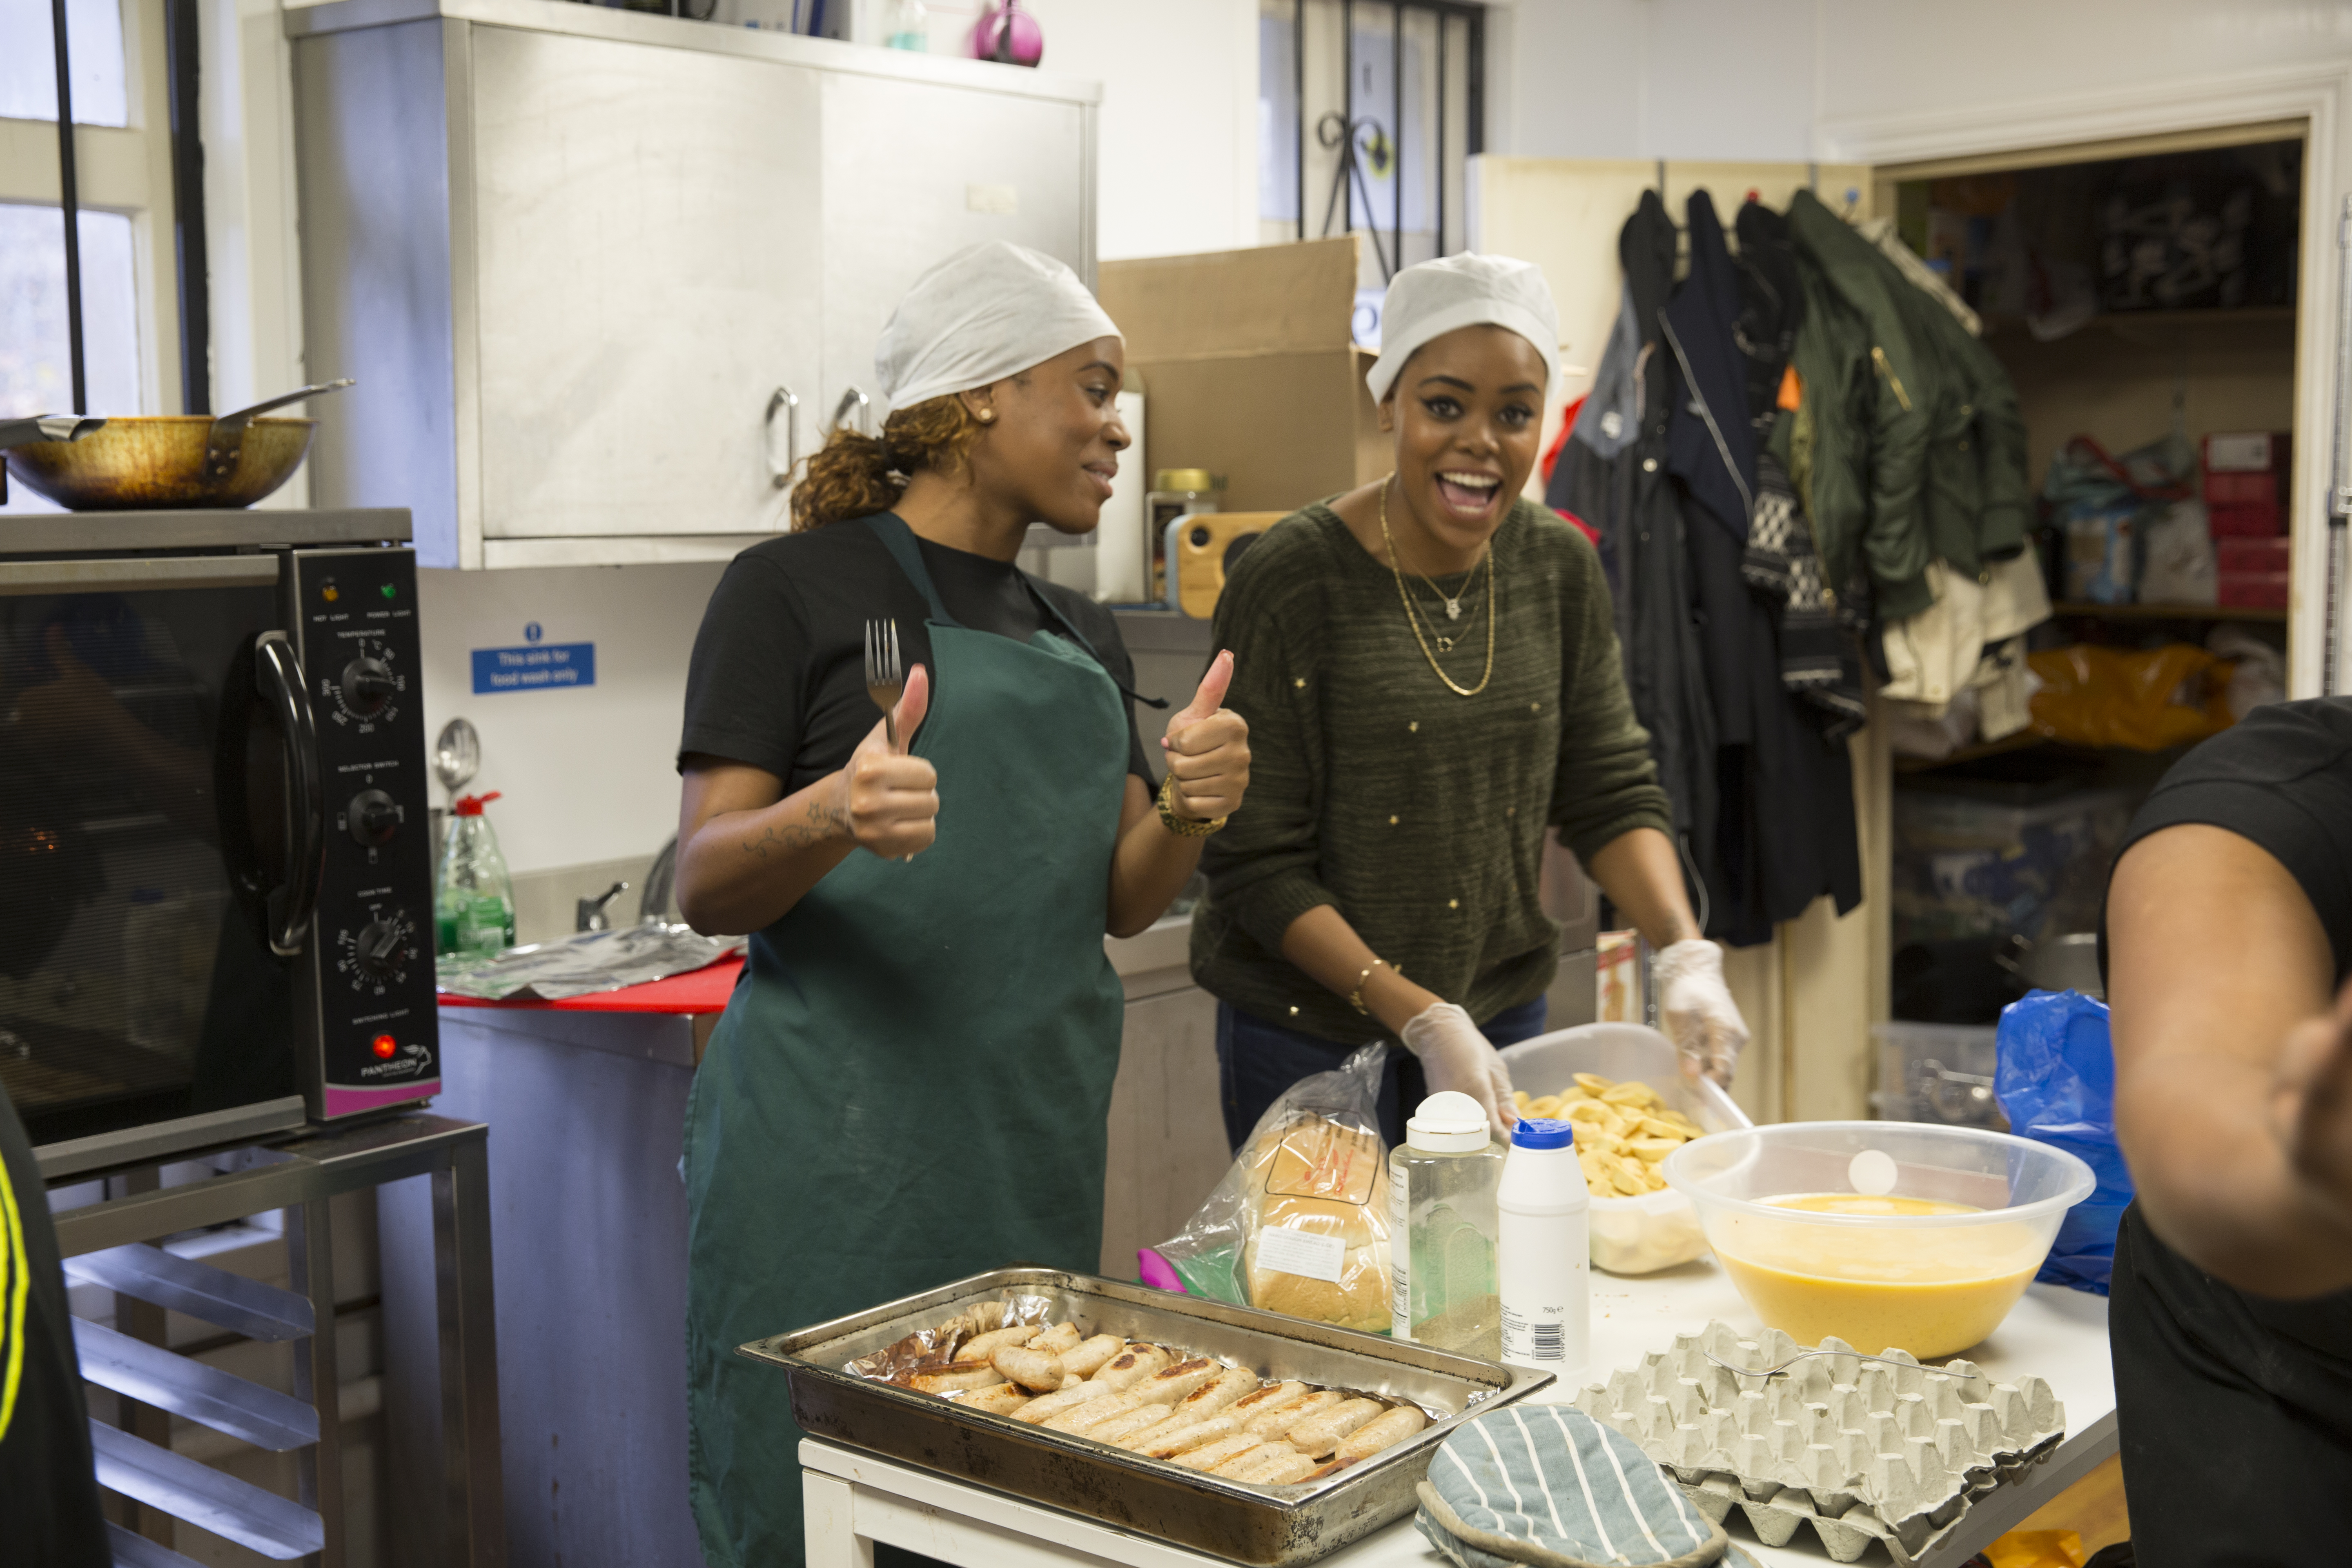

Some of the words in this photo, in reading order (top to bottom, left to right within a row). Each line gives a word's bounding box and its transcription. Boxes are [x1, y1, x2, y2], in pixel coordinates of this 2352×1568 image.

[337, 629, 385, 638] TEMPERATURE
[338, 763, 372, 772] SELECTOR
[374, 760, 399, 768] SWITCH
[352, 1013, 388, 1025] SWITCHING
[390, 1009, 409, 1018] LIGHT
[361, 1058, 416, 1077] PANTHEON
